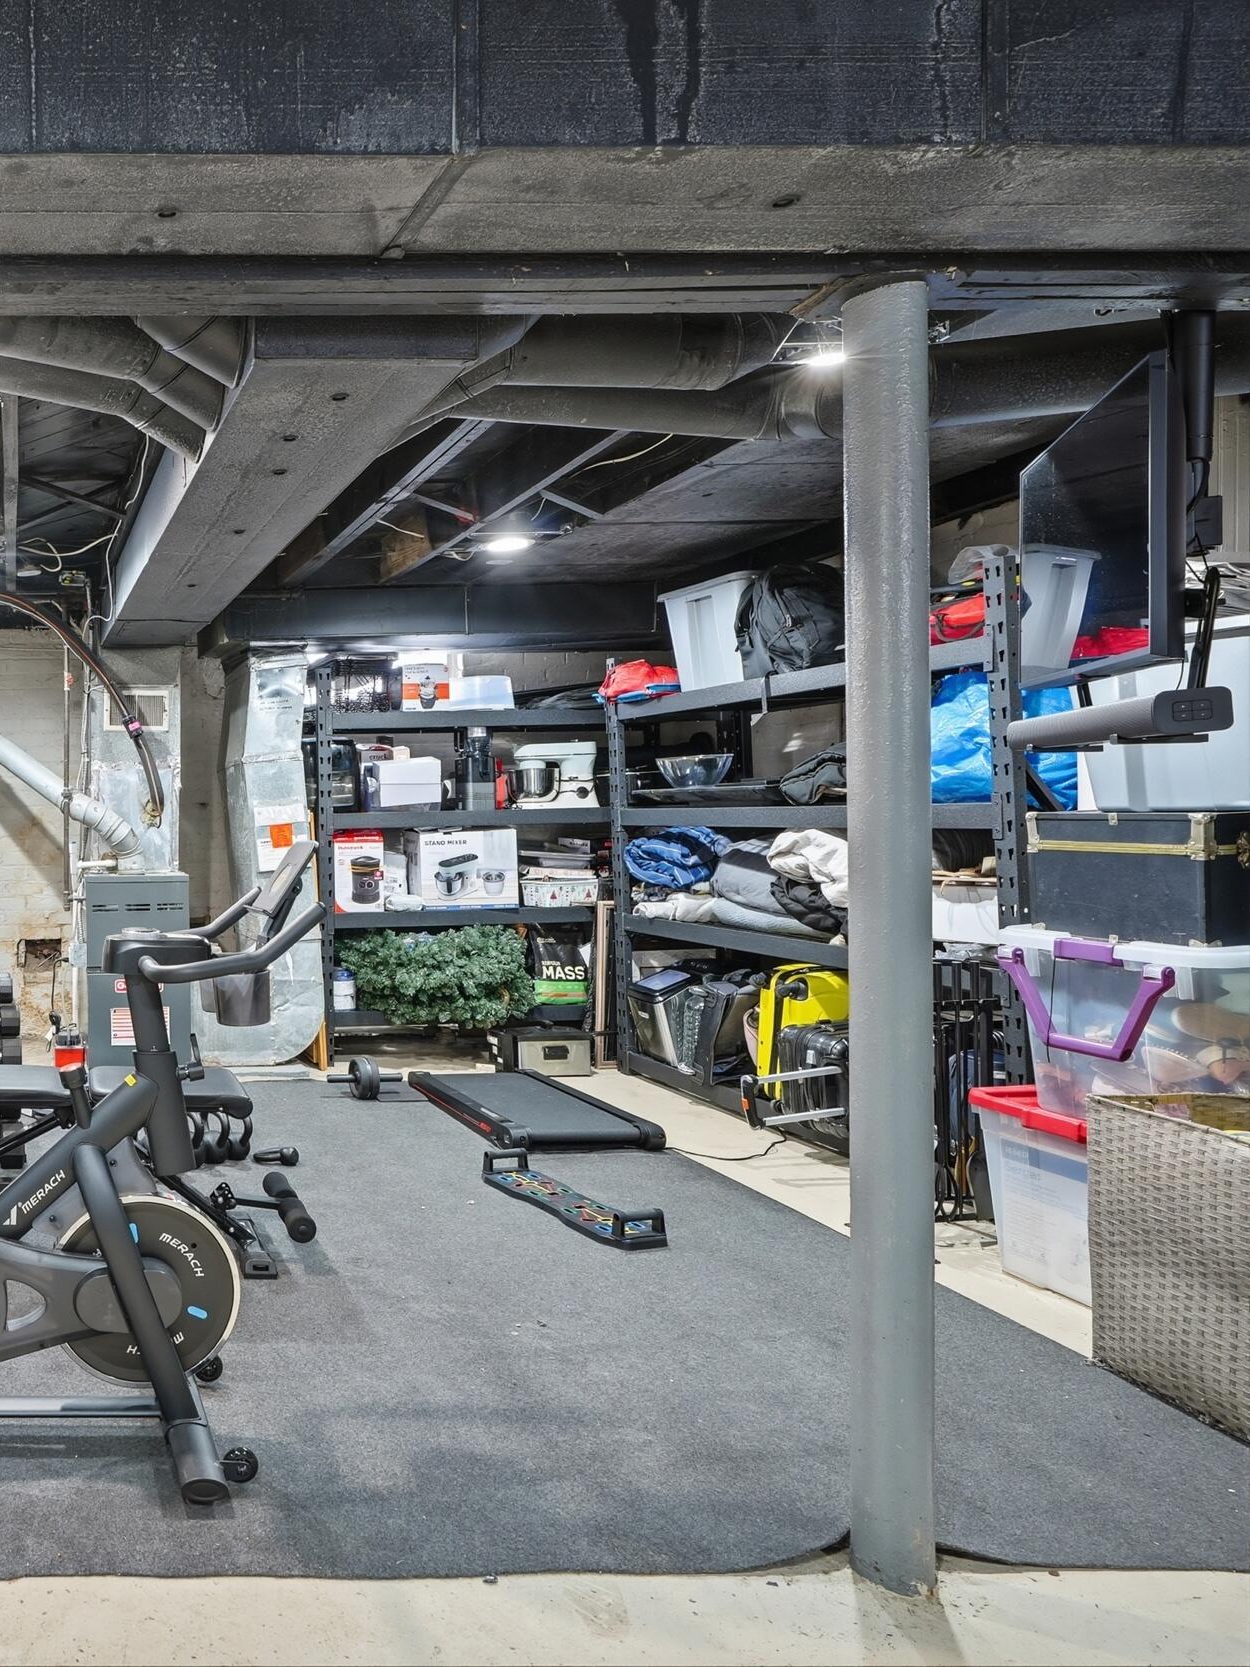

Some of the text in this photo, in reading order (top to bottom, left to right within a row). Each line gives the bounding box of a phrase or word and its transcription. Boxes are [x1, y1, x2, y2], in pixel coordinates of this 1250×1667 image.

[542, 965, 585, 980] MASS
[21, 1169, 66, 1214] MERACH
[158, 1232, 205, 1278] MERACH
